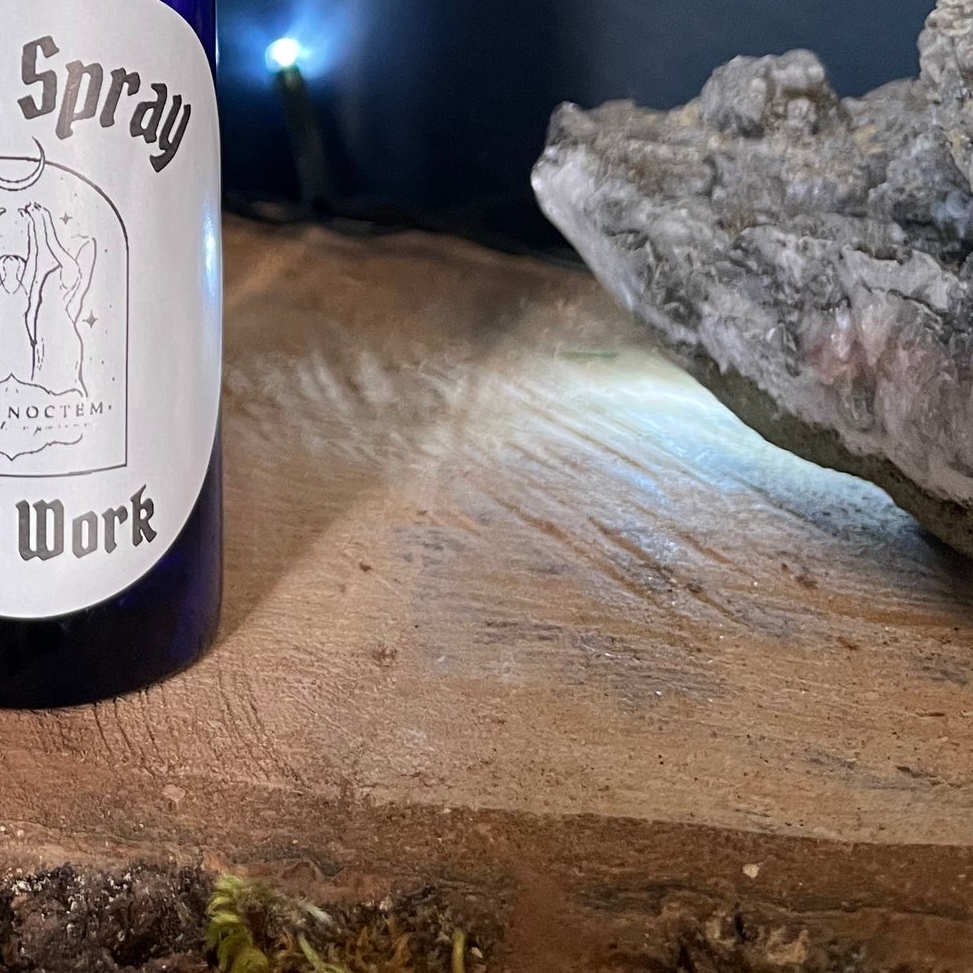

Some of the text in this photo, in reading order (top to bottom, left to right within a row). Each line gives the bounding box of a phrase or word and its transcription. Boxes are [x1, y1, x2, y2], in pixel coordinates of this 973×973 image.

[17, 35, 192, 173] Spray
[7, 401, 104, 419] NOCTEM
[15, 483, 158, 562] Work
